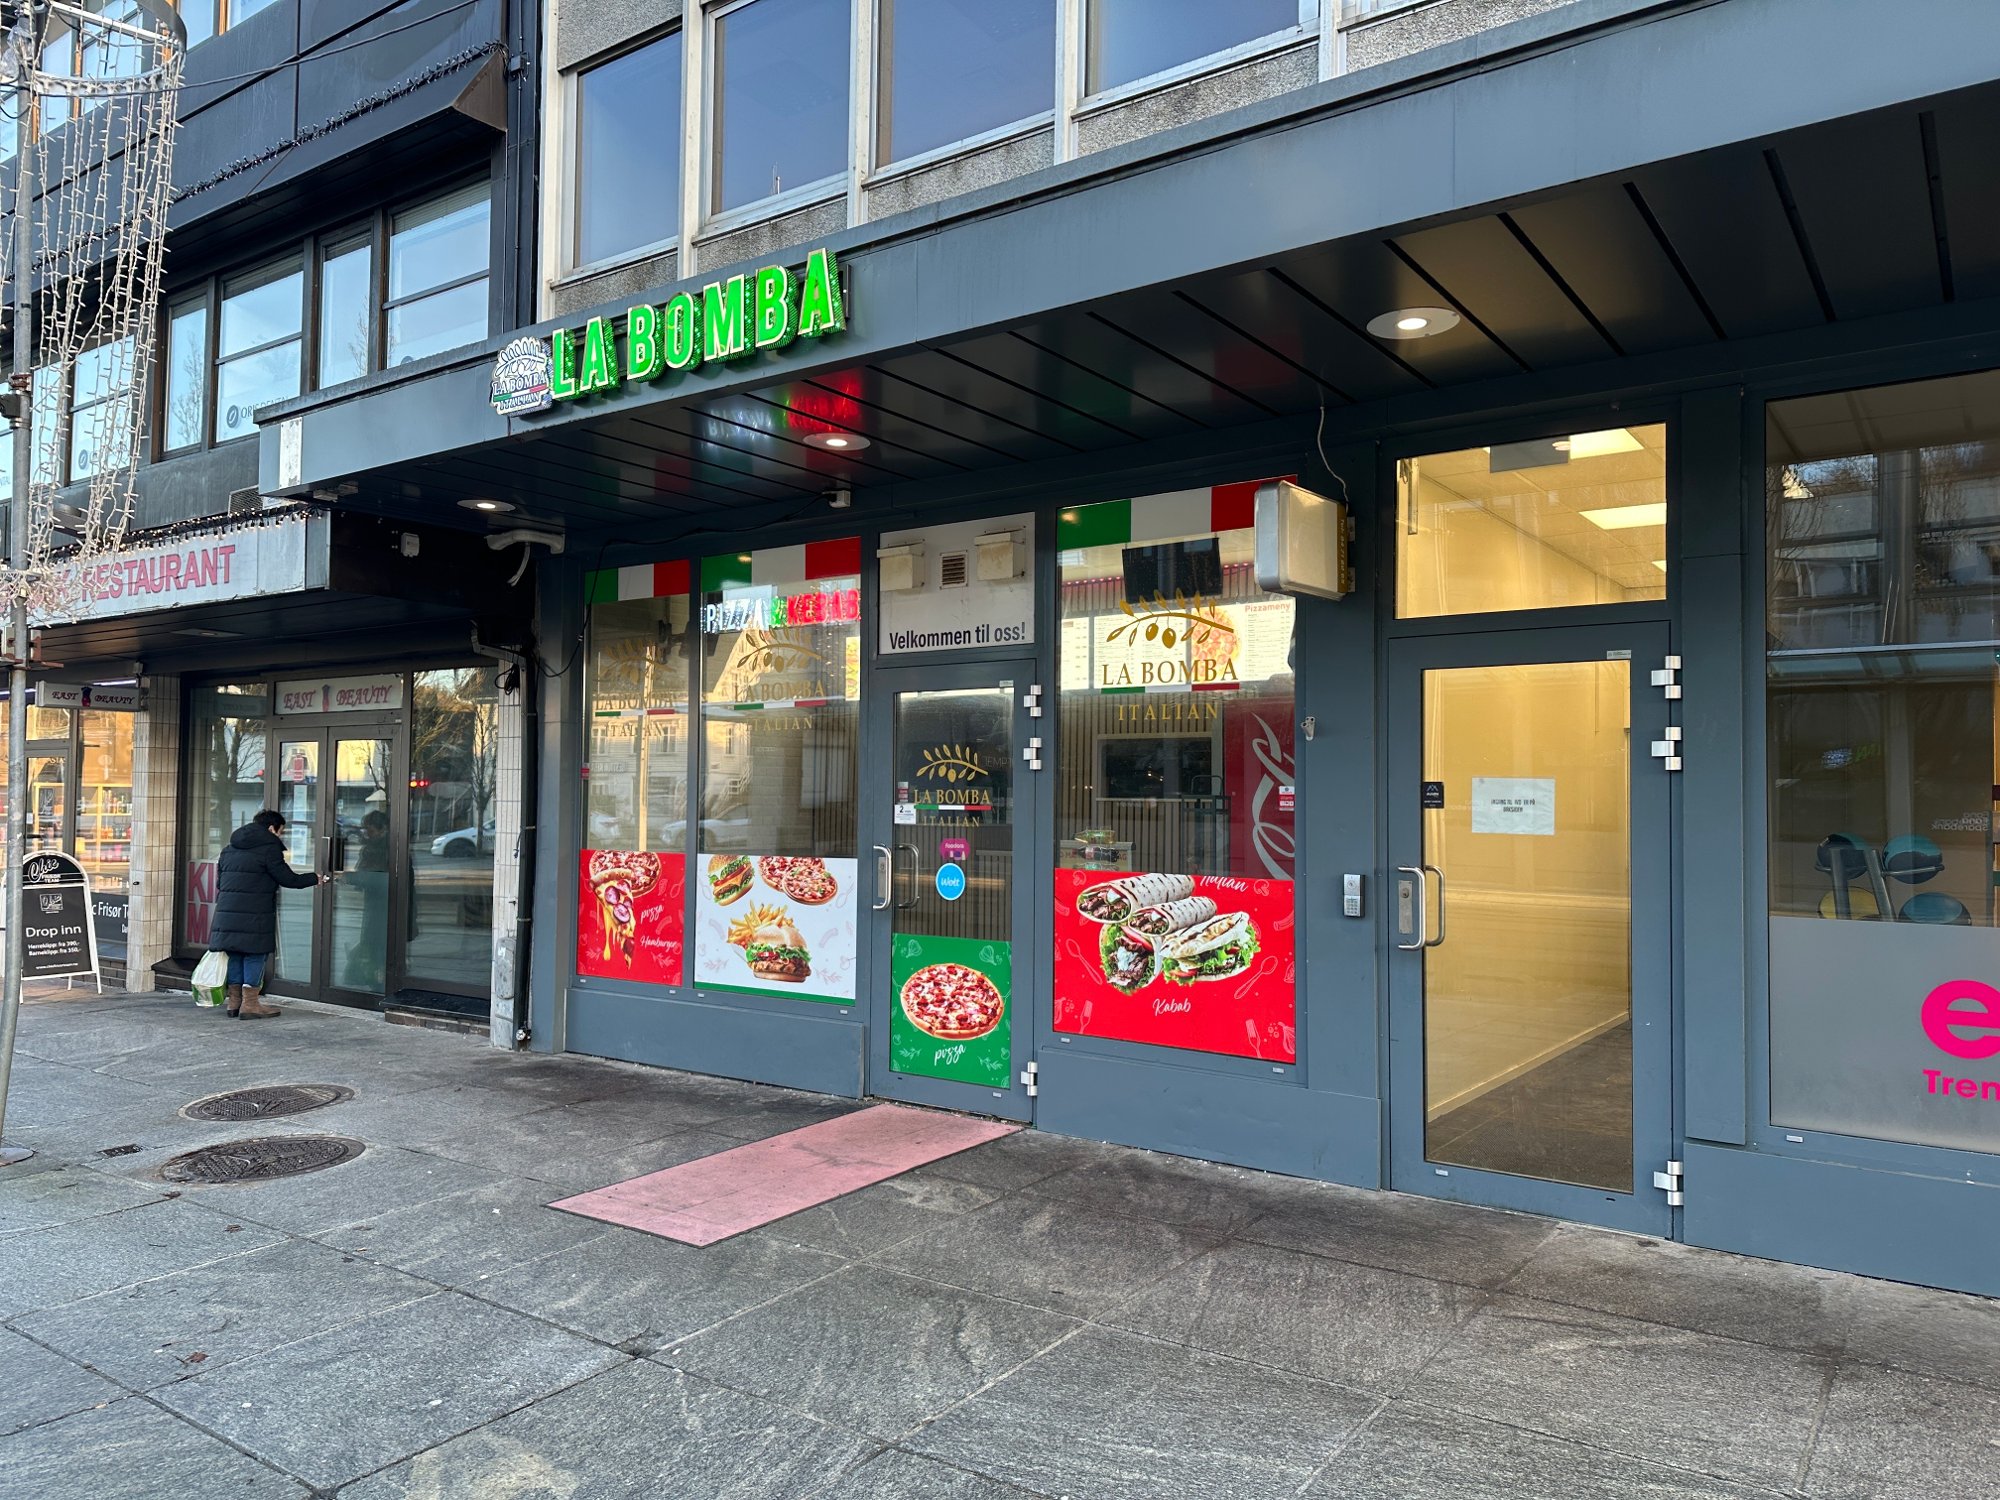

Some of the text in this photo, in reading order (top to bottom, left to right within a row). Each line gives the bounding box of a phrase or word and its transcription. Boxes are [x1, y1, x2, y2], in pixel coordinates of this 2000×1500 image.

[552, 248, 841, 400] LA BOMBA
[493, 370, 546, 396] LA BOMBA
[500, 391, 541, 411] ITALIAN
[82, 546, 236, 602] RESTAURANT
[705, 597, 767, 632] PIZZA
[787, 588, 860, 625] KEBAB
[1245, 602, 1291, 613] Pizzameny
[890, 621, 1026, 650] Velkommen til oss!
[1102, 658, 1239, 686] LA BOMBA
[52, 691, 136, 705] EAST BEAUTY
[284, 685, 392, 708] EAST BEAUTY
[734, 680, 826, 703] LA BOMBA
[1118, 702, 1218, 721] ITALIAN
[746, 716, 814, 732] ITALIAN
[914, 789, 932, 805] LA
[936, 789, 991, 805] BOMBA
[923, 816, 980, 828] ITALIAN
[98, 902, 122, 918] Frisør
[640, 904, 664, 924] pizza
[26, 925, 81, 938] Drop inn
[640, 934, 678, 953] Hamburger
[1152, 997, 1192, 1016] Kabab
[934, 1043, 966, 1066] pizza
